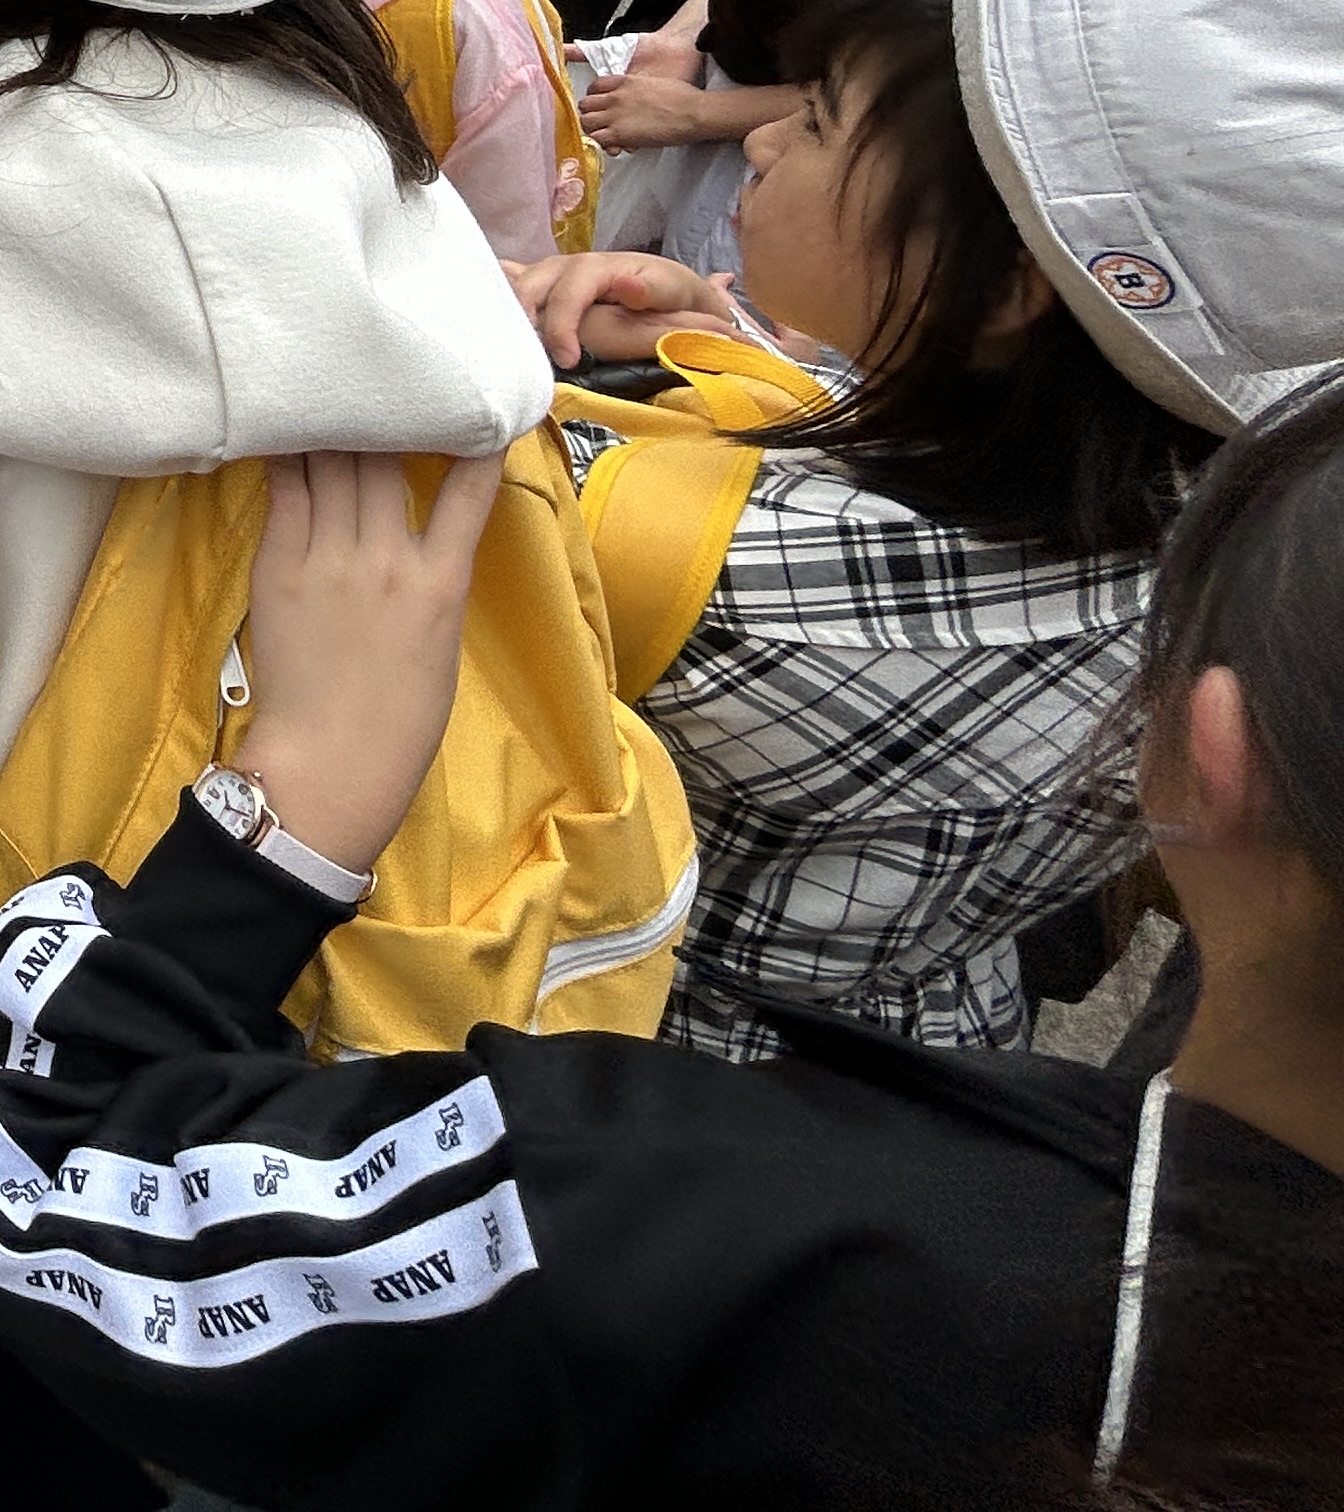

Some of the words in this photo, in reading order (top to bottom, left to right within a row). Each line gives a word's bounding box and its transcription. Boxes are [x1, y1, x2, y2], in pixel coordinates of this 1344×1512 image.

[13, 924, 68, 992] ANAP
[334, 1141, 398, 1199] ANAP
[25, 1269, 103, 1310] ANAP
[371, 1248, 455, 1303] ANAP
[197, 1295, 271, 1340] ANAP
